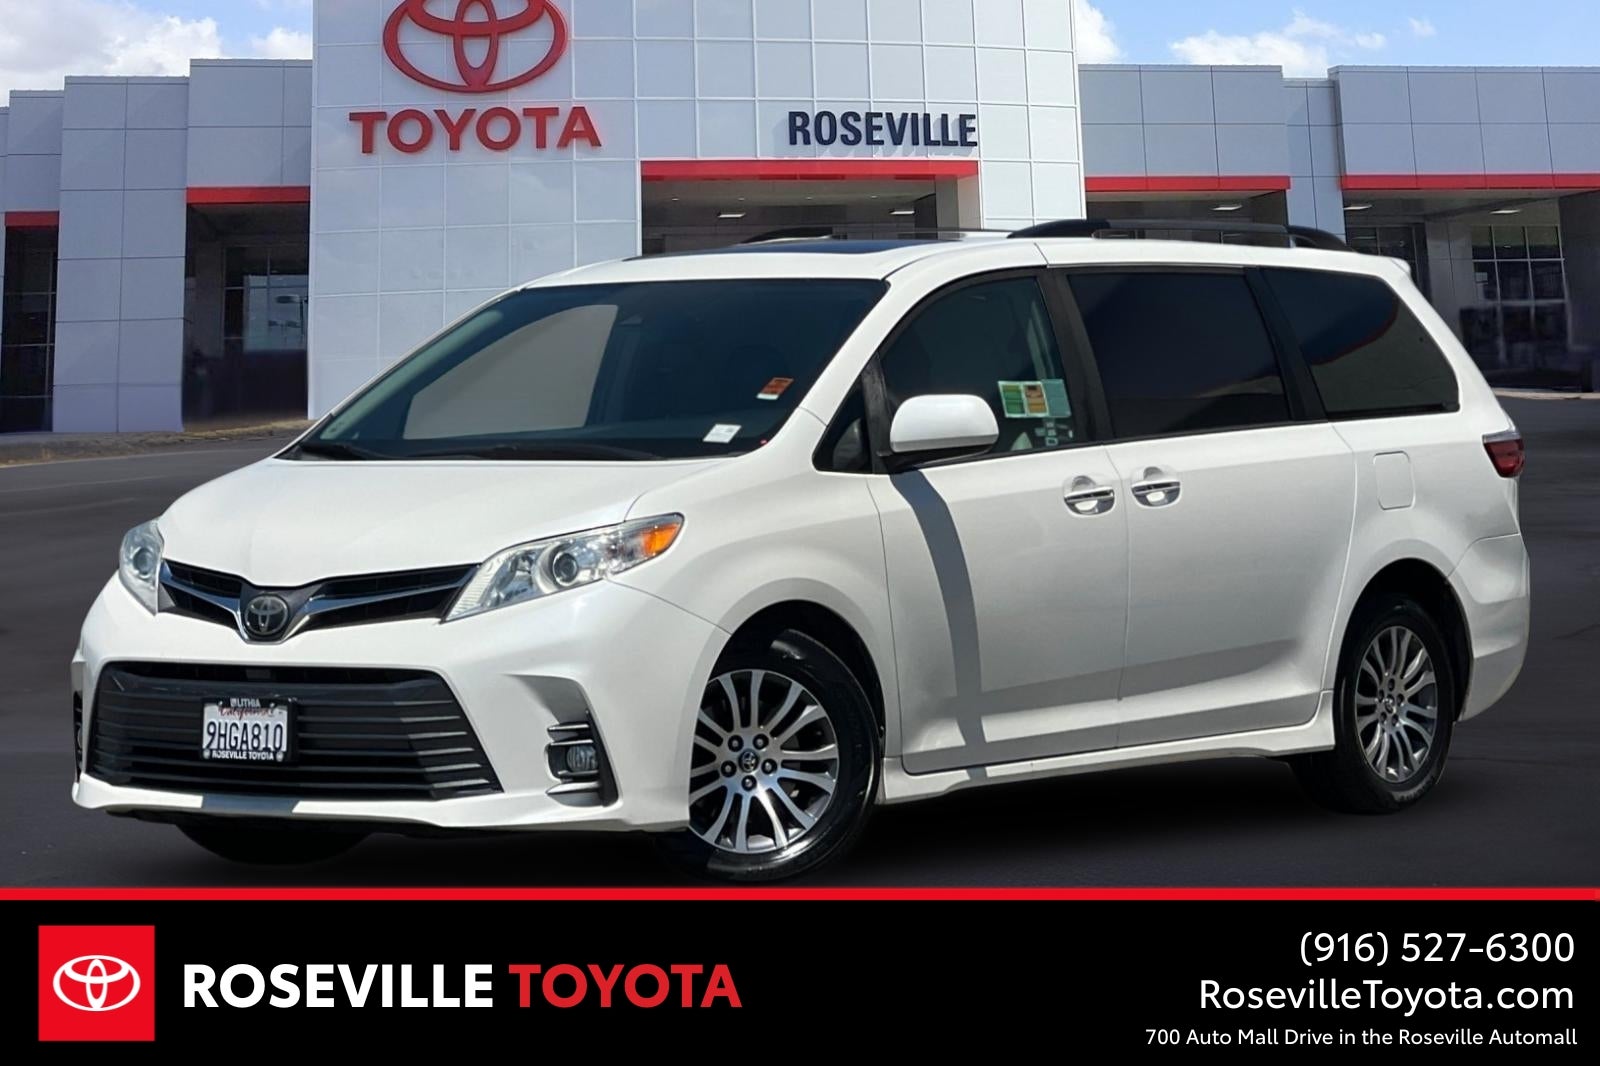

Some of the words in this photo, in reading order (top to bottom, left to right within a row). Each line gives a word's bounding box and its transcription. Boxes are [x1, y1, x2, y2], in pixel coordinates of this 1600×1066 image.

[349, 106, 602, 154] TOYOTA
[788, 110, 979, 147] ROSEVILLE
[205, 721, 283, 751] 9HGA810
[212, 751, 247, 759] ROSEVILLE
[249, 751, 274, 760] TOYOTA
